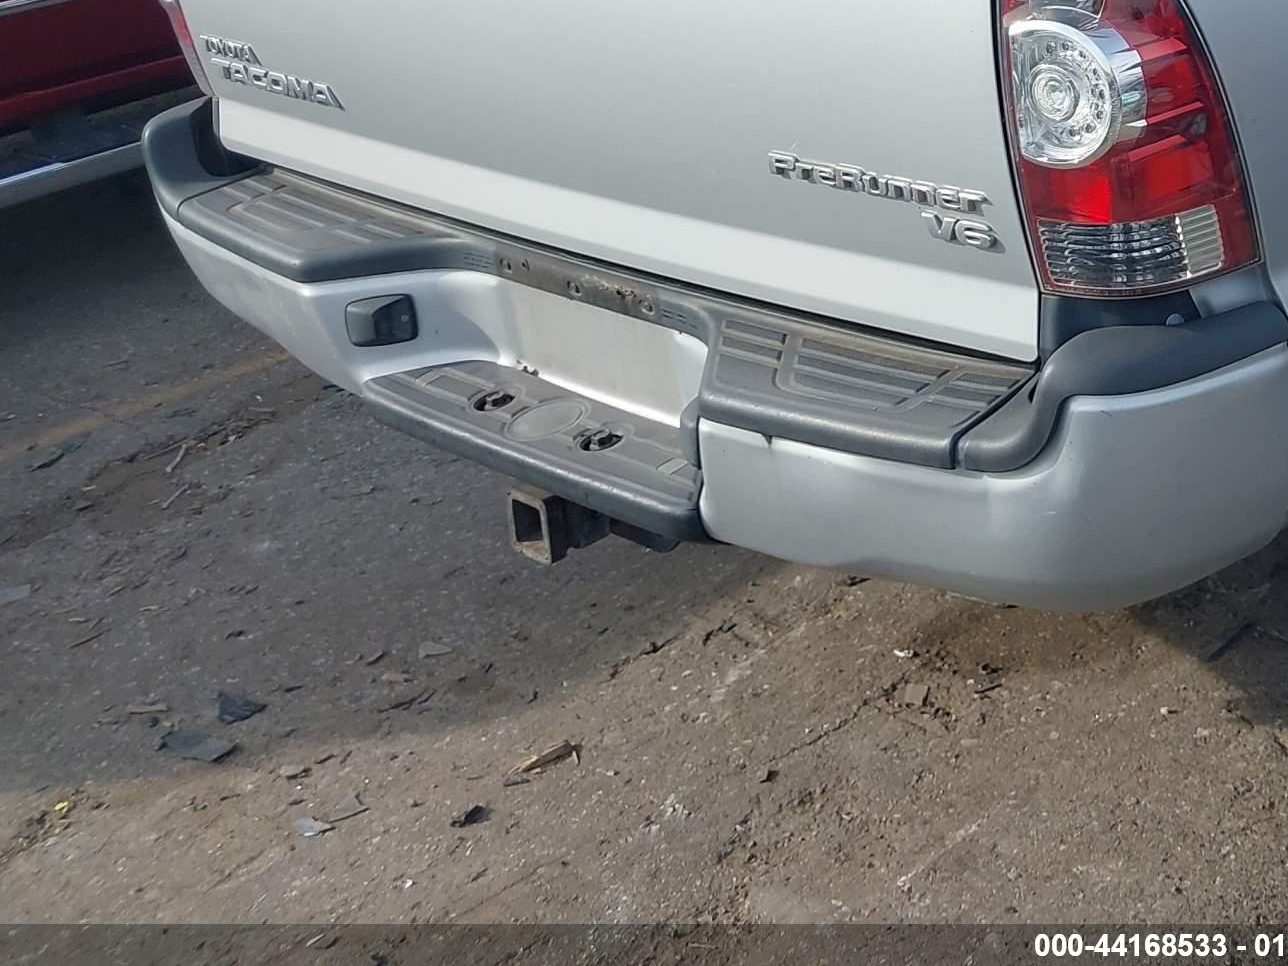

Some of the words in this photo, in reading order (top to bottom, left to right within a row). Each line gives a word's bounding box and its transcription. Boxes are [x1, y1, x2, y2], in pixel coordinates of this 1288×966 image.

[200, 34, 262, 67] TOYOTA
[210, 57, 346, 112] TACOMA
[767, 149, 993, 217] PreRunner
[920, 209, 1006, 254] V6
